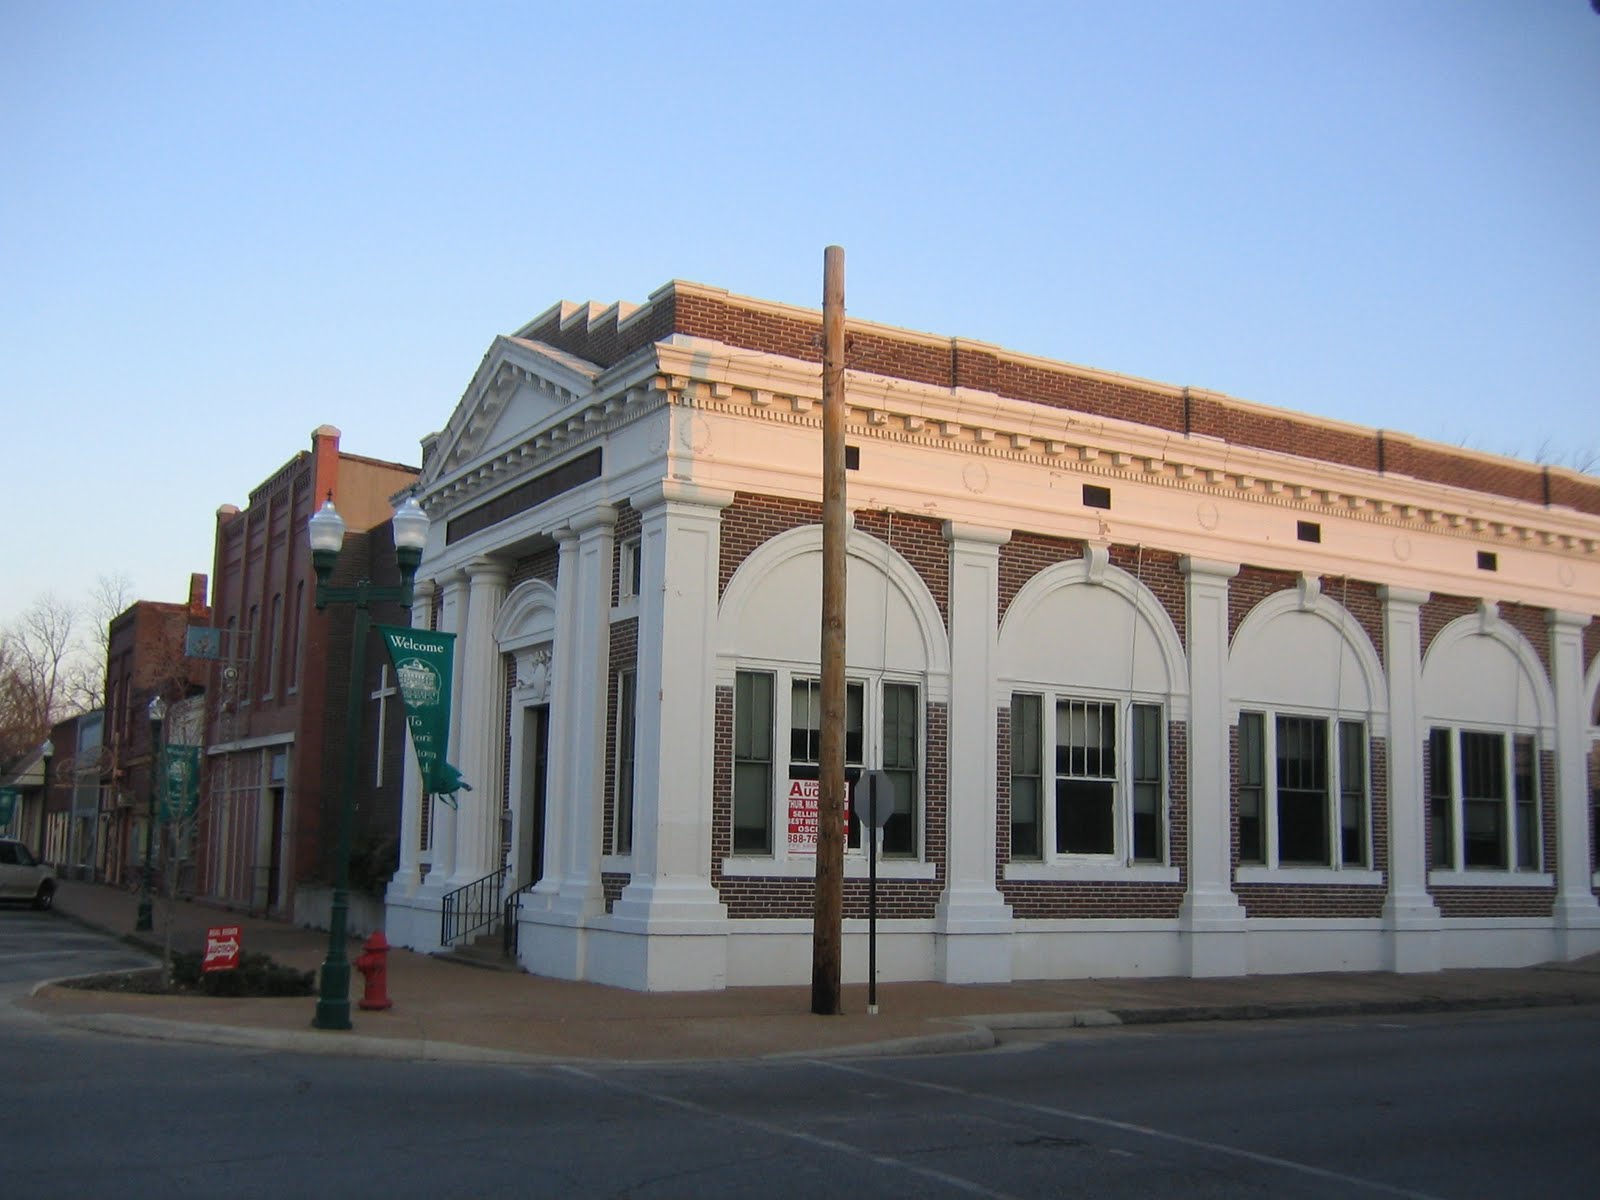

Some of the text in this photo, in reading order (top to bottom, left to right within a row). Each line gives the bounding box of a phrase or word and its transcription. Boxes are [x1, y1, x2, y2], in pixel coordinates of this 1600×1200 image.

[390, 634, 444, 653] Welcome
[408, 715, 422, 727] To
[789, 781, 819, 797] AUC
[793, 810, 818, 818] SELLIN
[788, 834, 818, 843] 888-76
